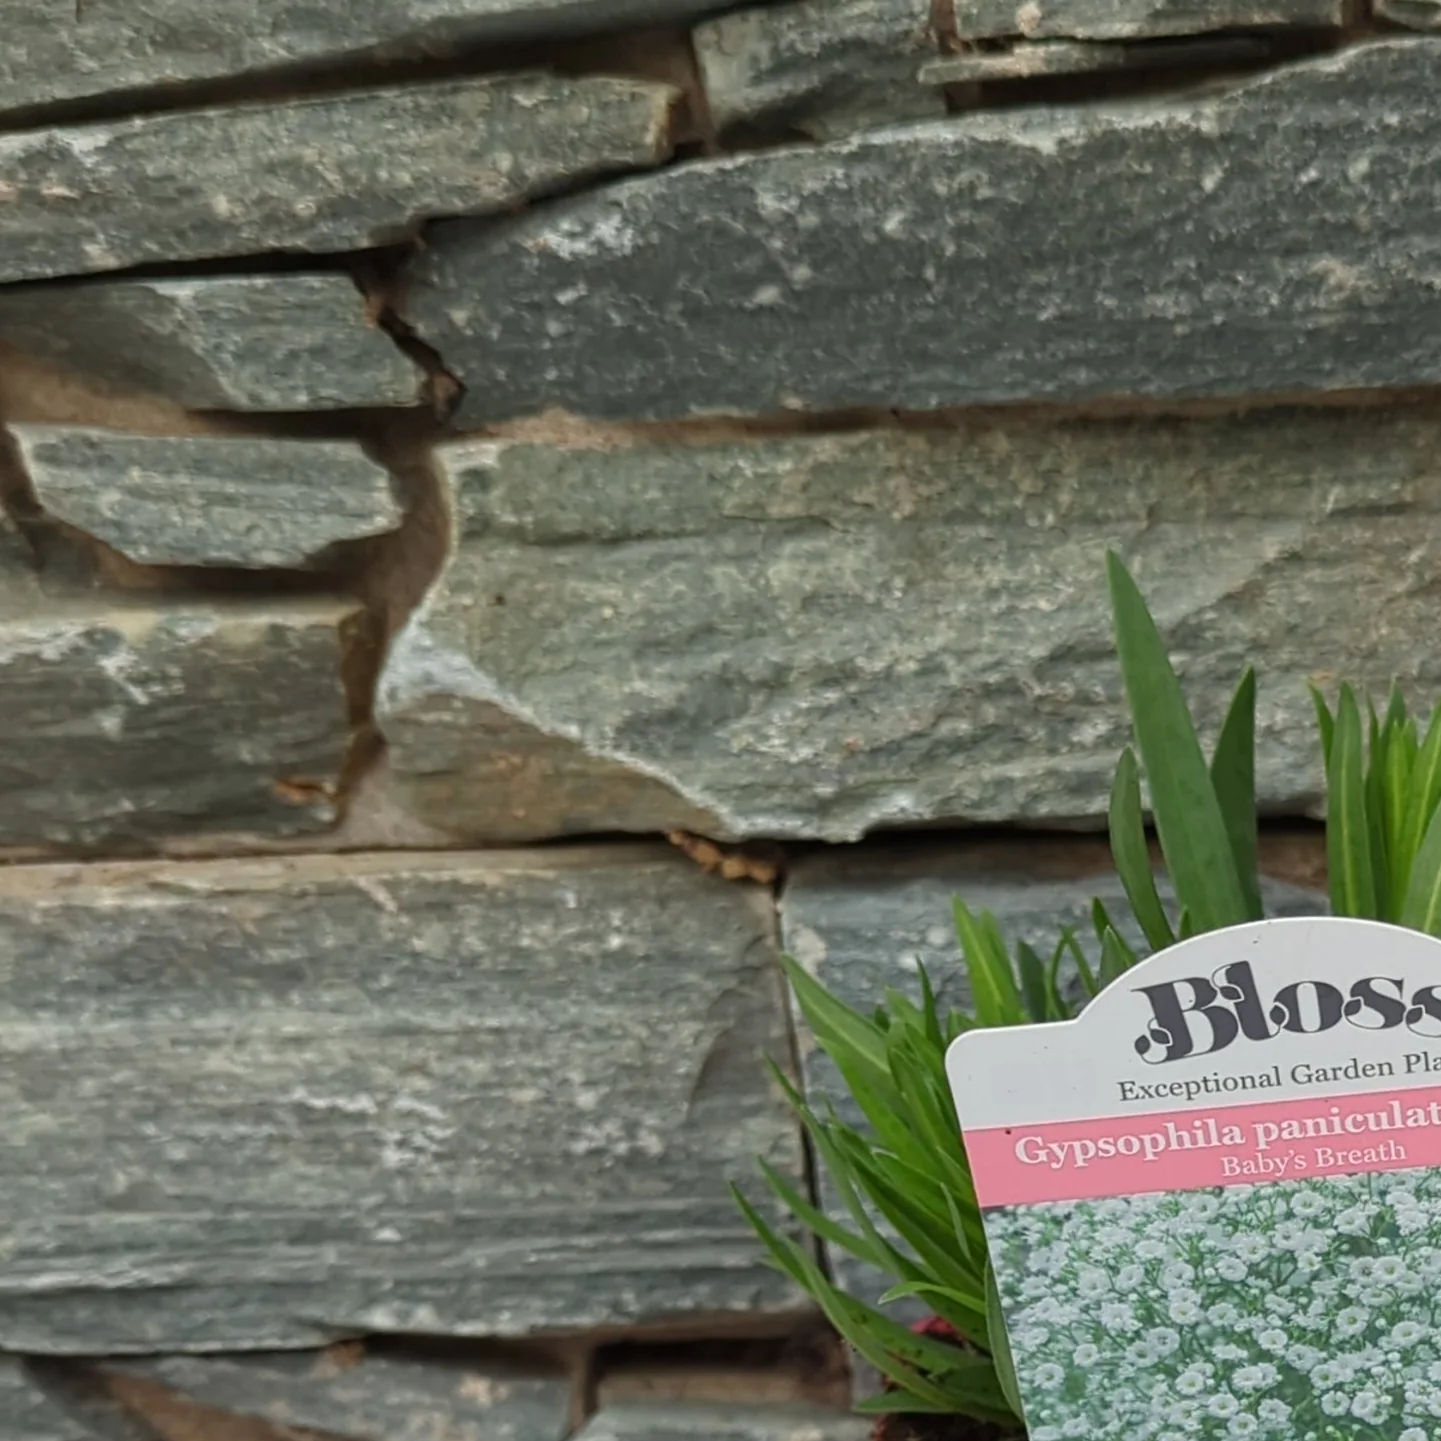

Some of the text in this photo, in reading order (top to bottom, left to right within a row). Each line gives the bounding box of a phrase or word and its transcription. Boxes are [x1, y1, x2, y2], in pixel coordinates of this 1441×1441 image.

[1116, 1066, 1282, 1101] Exceptional
[1290, 1058, 1396, 1086] Garden
[1015, 1118, 1246, 1169] Gypsophila
[1221, 1140, 1407, 1178] Baby's Breath
